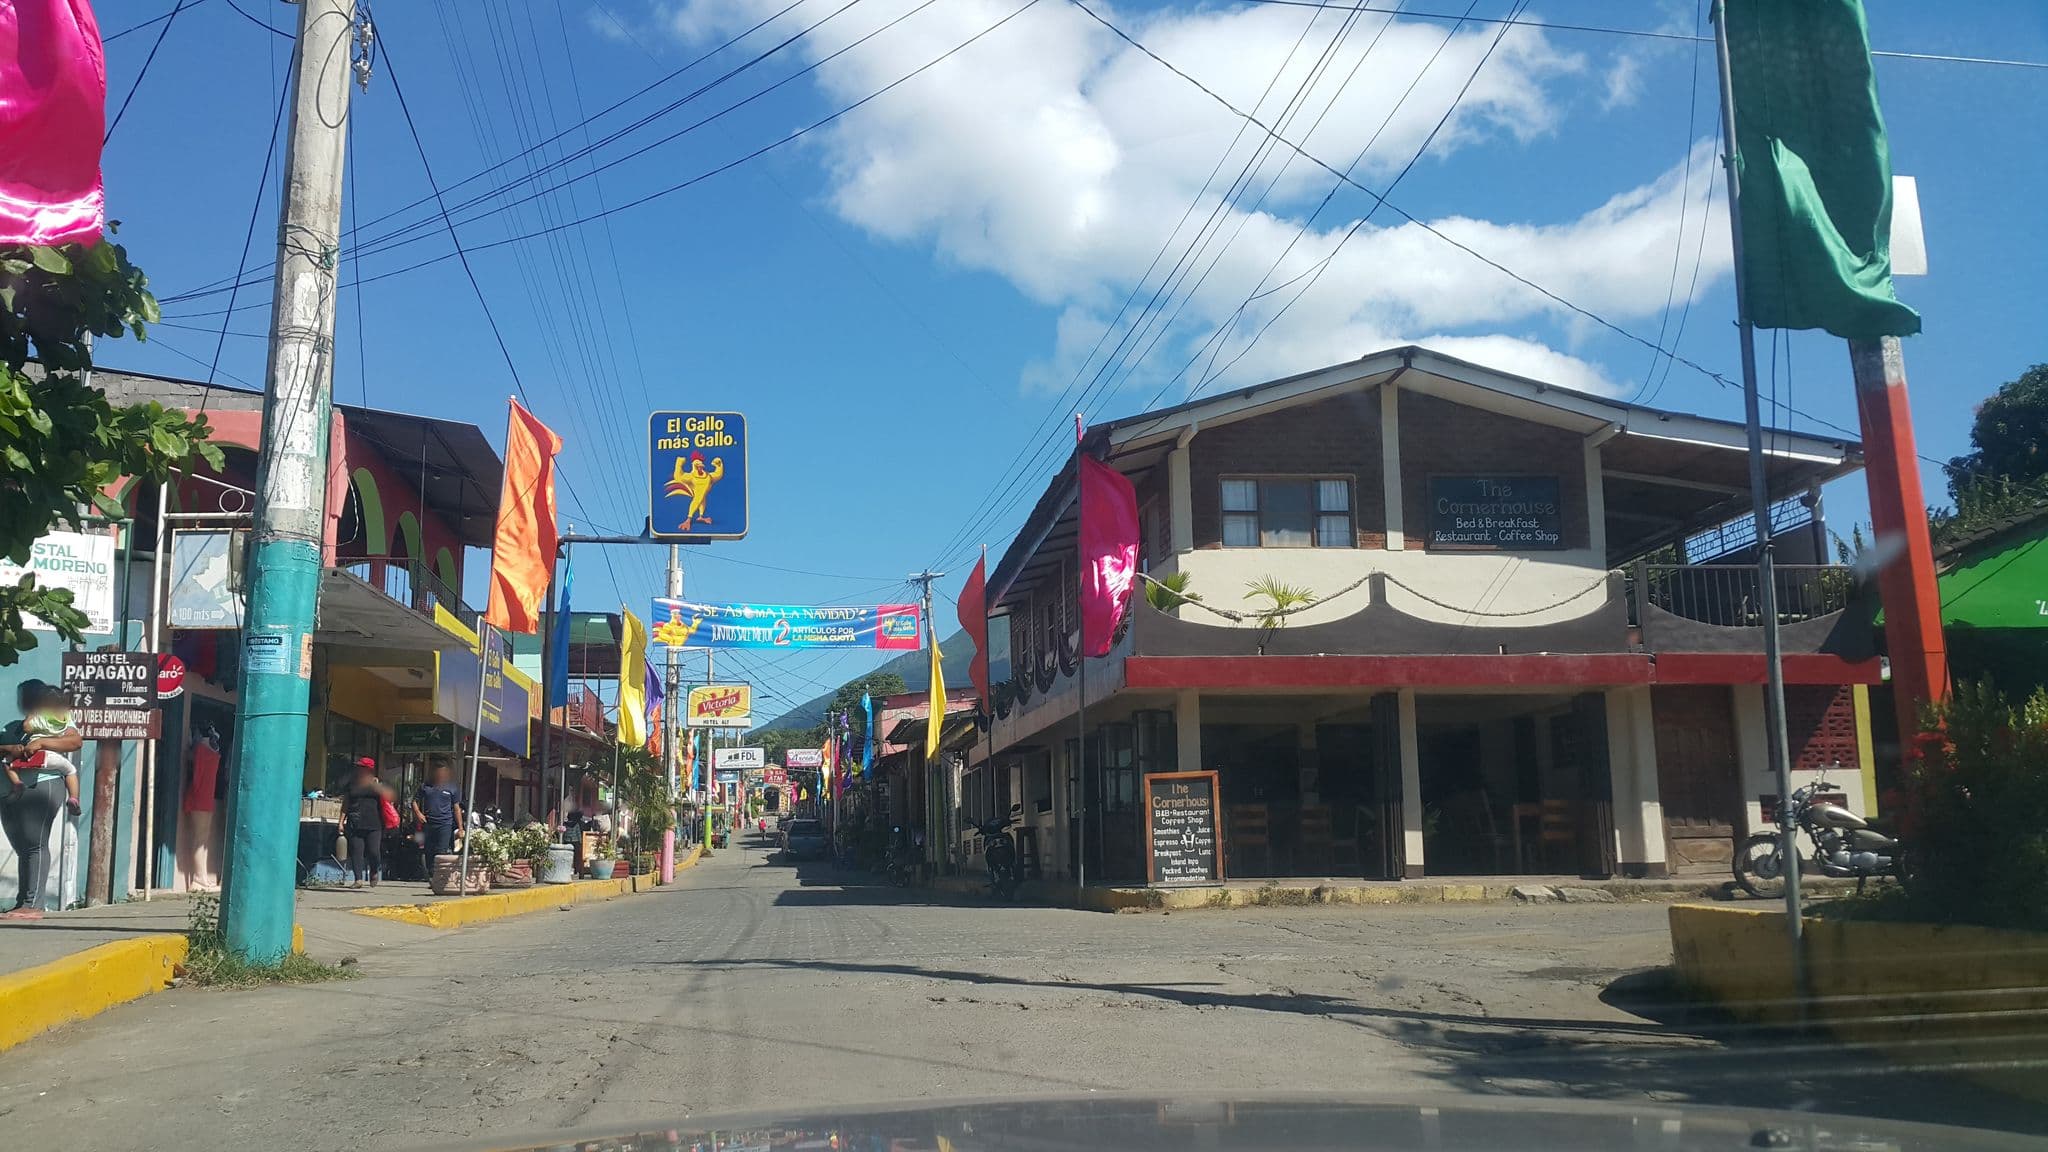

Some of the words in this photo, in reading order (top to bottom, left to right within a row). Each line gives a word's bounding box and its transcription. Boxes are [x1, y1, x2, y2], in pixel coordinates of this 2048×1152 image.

[667, 417, 681, 433] El
[685, 415, 725, 432] Gallo
[657, 434, 690, 450] más
[1477, 479, 1513, 497] The
[1437, 497, 1556, 515] Cornerhouse
[1456, 517, 1476, 528] Bed
[1485, 517, 1540, 529] Breakfast
[1435, 530, 1492, 542] Restaurant
[1498, 530, 1532, 542] Coffee
[1534, 530, 1559, 544] Shop
[29, 542, 78, 558] STAL
[33, 557, 108, 575] MORENO
[773, 618, 791, 646] 2
[838, 627, 854, 635] POR
[85, 653, 130, 665] HOSTEL
[65, 664, 147, 680] PAPAGAYO
[84, 693, 93, 707] $
[702, 696, 736, 711] Victoria
[83, 709, 103, 724] VIBES
[103, 709, 151, 725] ENVIRONMENT
[124, 725, 147, 737] drinks
[741, 751, 757, 761] FDL
[1171, 783, 1189, 794] The
[1187, 816, 1204, 825] Shop
